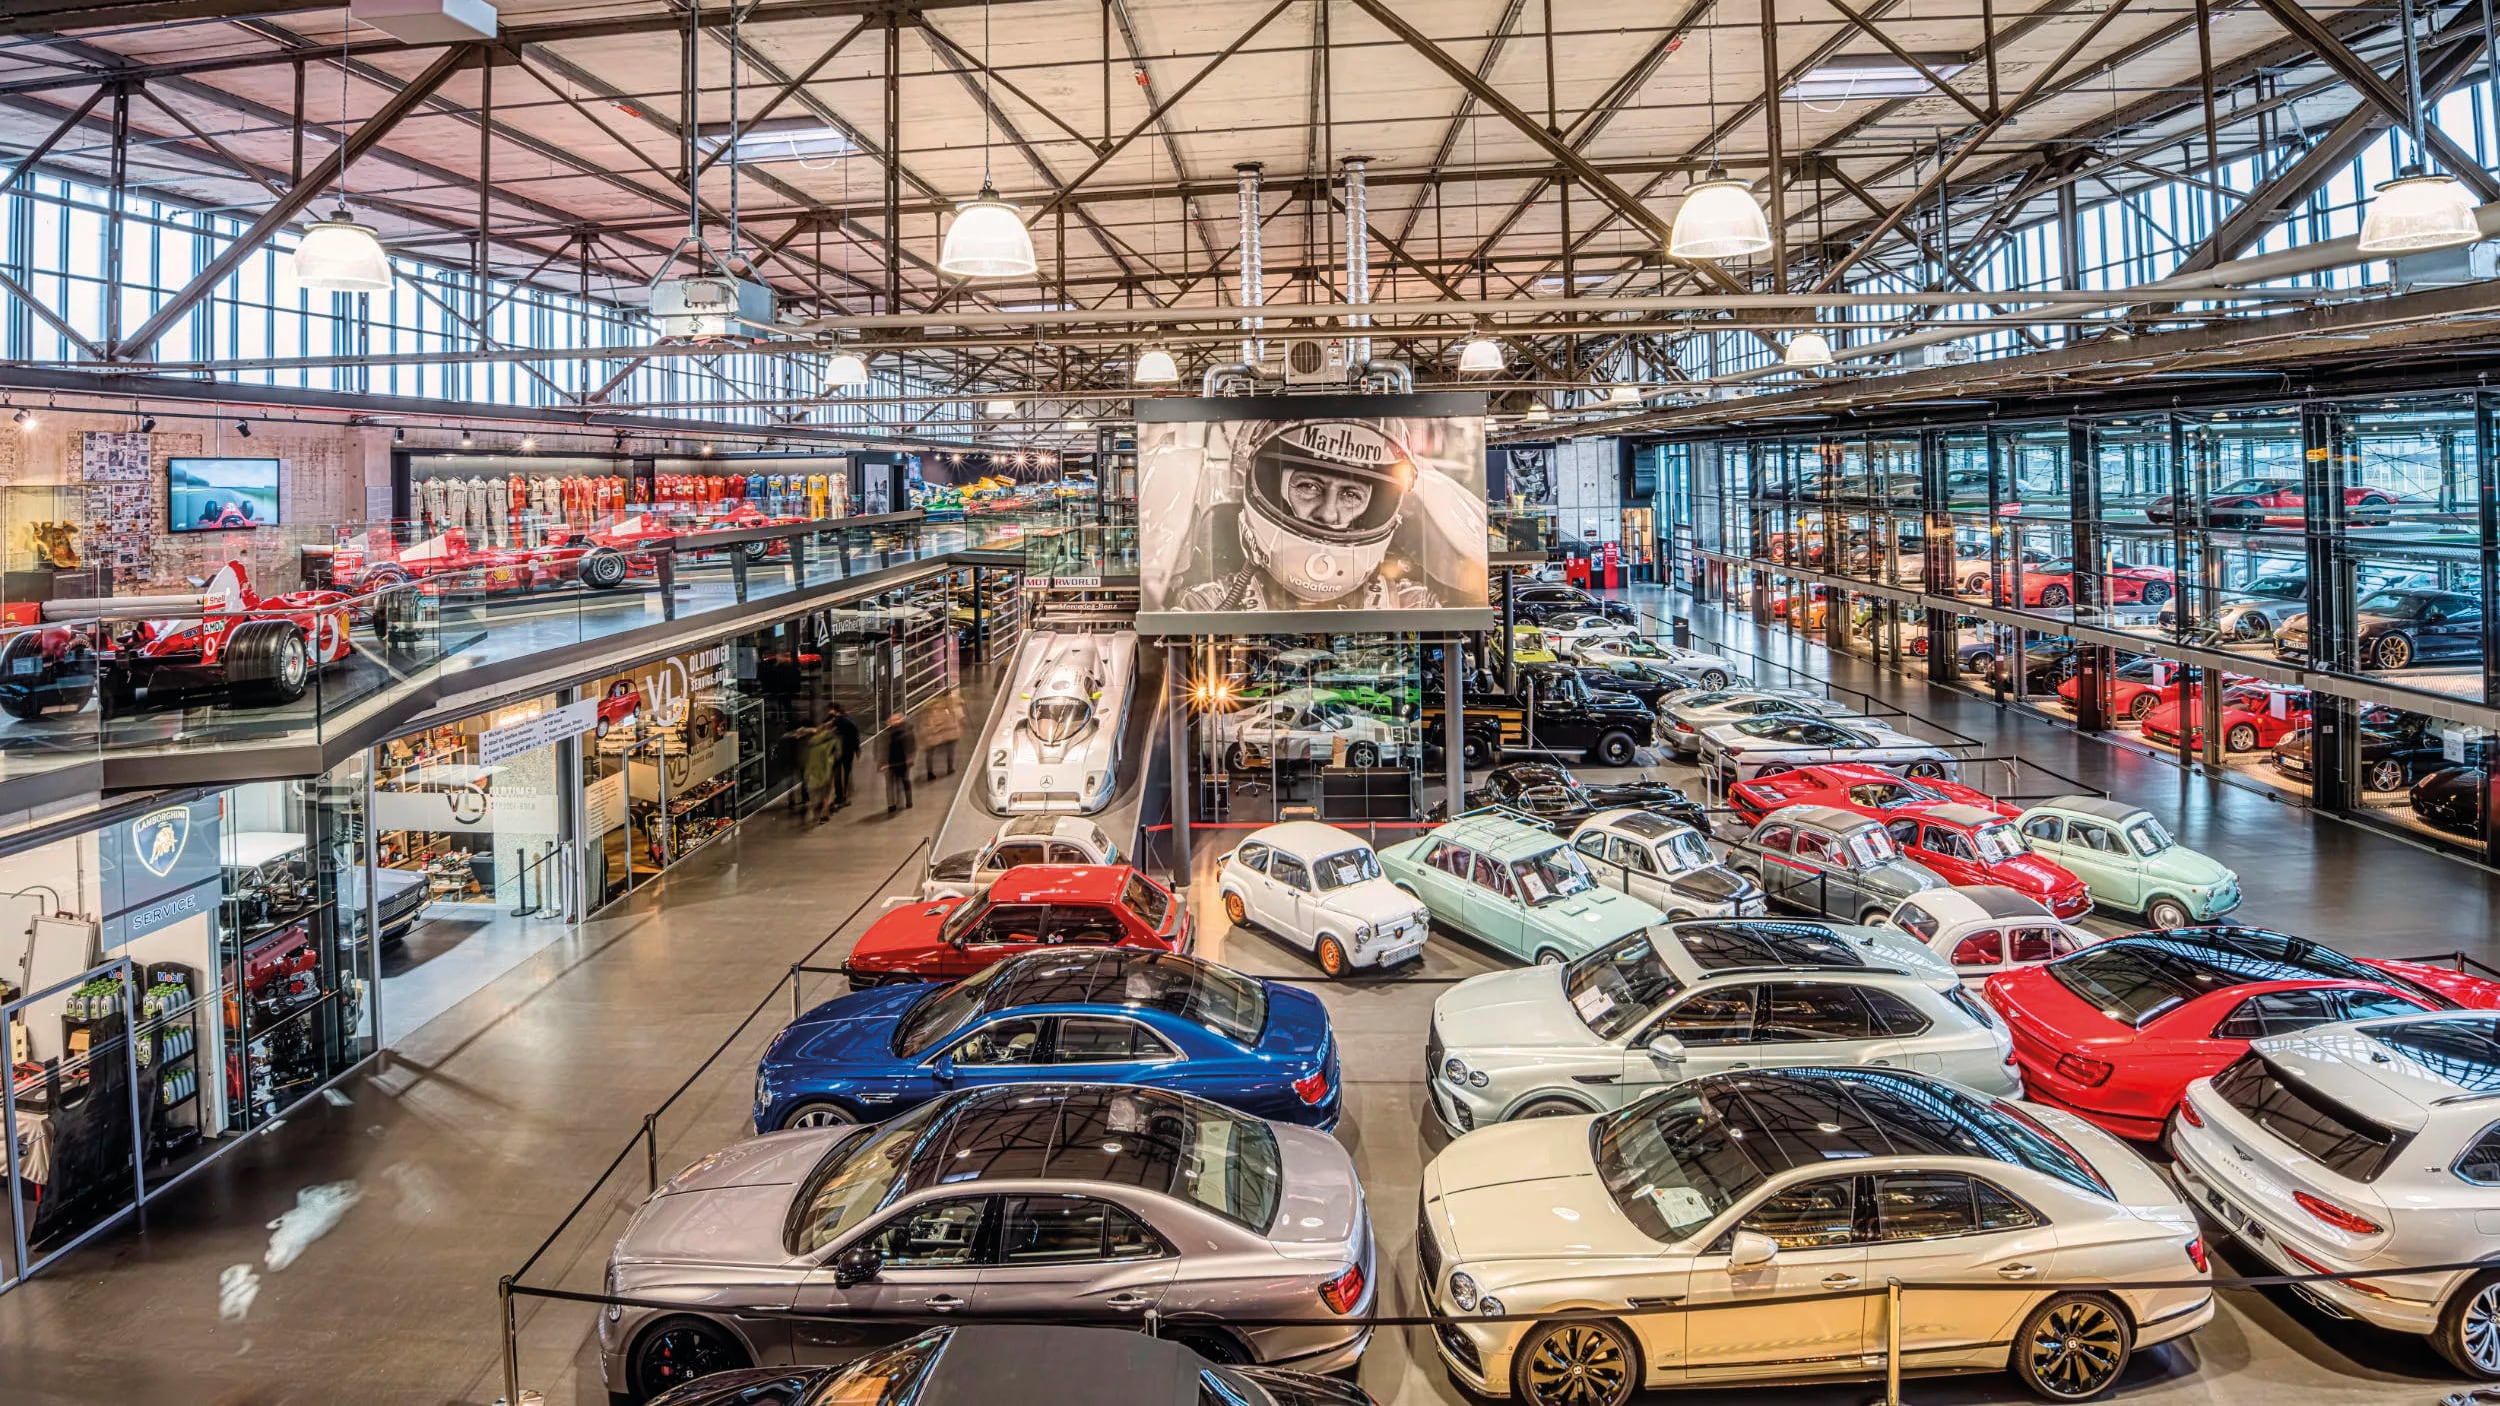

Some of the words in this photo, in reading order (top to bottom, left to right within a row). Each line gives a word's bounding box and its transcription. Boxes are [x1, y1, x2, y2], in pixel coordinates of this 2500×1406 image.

[2462, 394, 2474, 404] 35
[1301, 425, 1382, 462] Marlboro
[1026, 578, 1098, 587] MOTRWORLD
[1289, 575, 1342, 593] vodafone
[209, 594, 226, 604] Shell
[204, 622, 220, 633] AMD
[690, 645, 729, 673] OLDTIMER
[993, 749, 1007, 766] 2
[136, 810, 187, 833] LAMBORGHINI
[132, 894, 195, 930] SERVICE
[157, 971, 184, 983] Mobil
